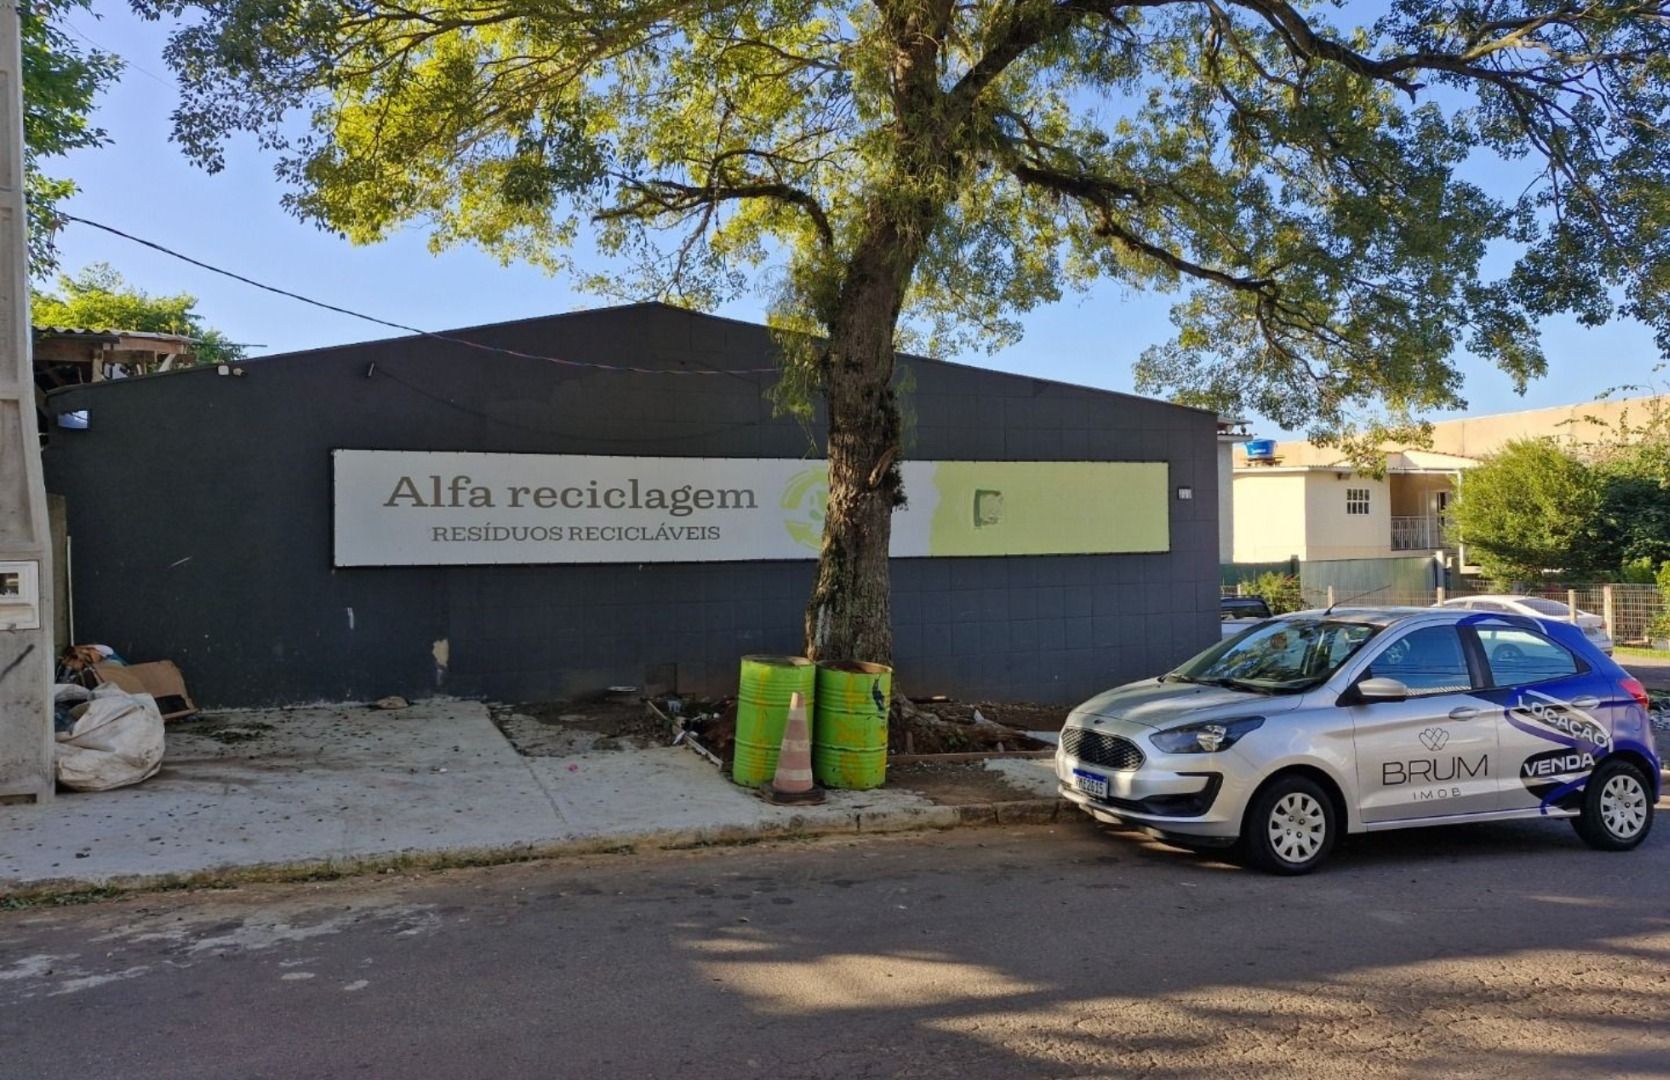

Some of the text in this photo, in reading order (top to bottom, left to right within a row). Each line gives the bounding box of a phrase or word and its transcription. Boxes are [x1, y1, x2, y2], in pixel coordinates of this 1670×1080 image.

[383, 475, 758, 517] Alfa reciclagem
[432, 522, 721, 542] RESÍDUOS RECICLÁVEIS
[1517, 695, 1609, 748] LOCAÇÃO
[1382, 754, 1488, 786] BRUM
[1524, 752, 1595, 777] VENDA
[1413, 787, 1461, 800] IMOB
